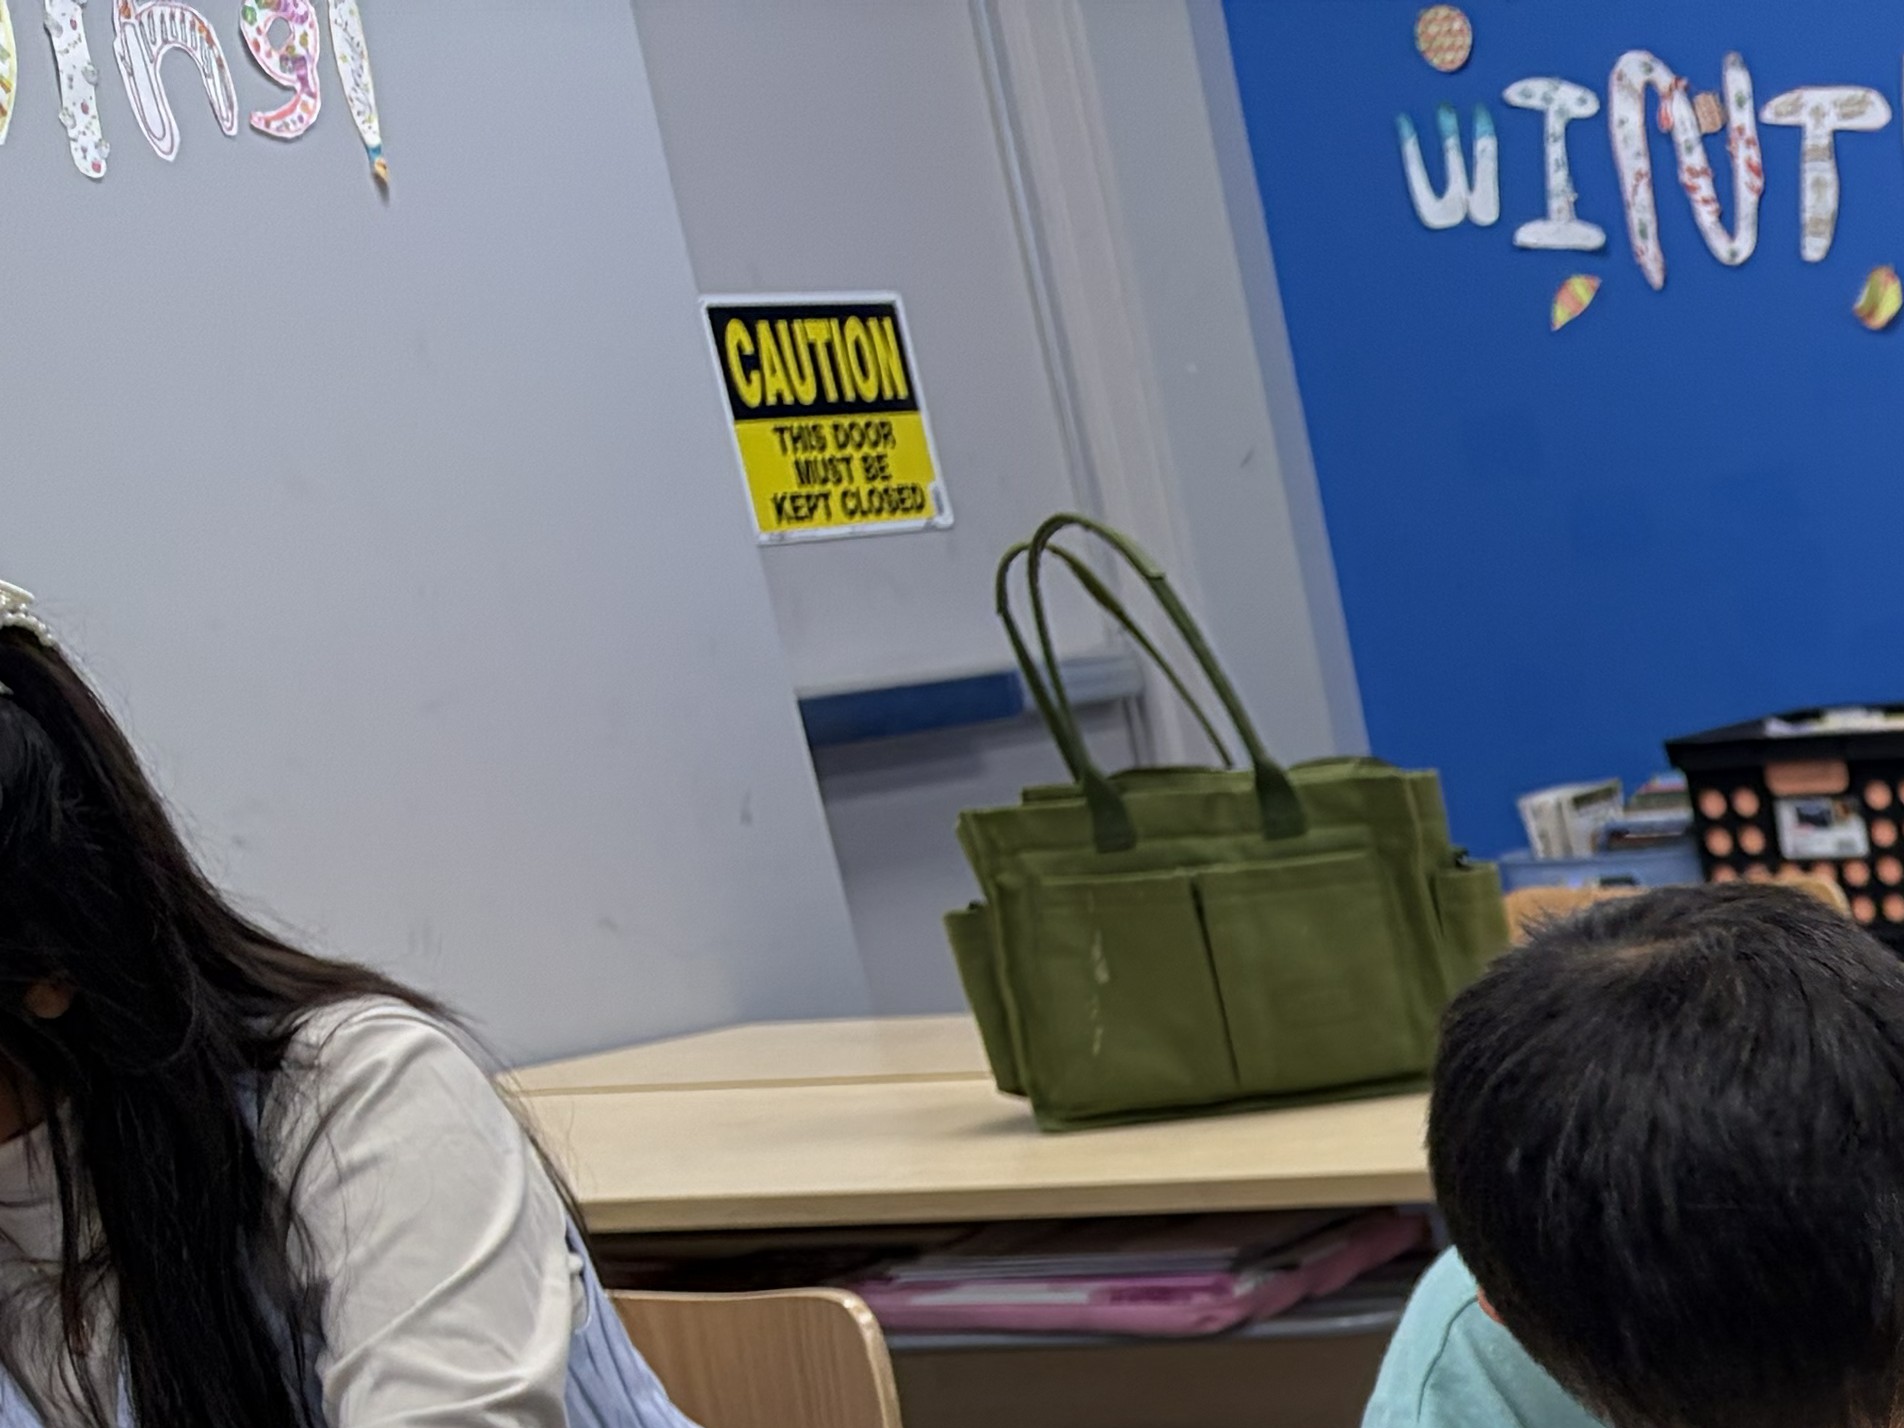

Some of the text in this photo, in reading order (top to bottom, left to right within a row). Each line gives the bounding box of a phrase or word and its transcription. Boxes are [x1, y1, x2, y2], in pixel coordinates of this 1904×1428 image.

[725, 315, 909, 408] CAUTION
[772, 420, 896, 456] THIS DOOR
[795, 453, 892, 486] MUST BE
[771, 483, 926, 525] KEPT CLOSED
